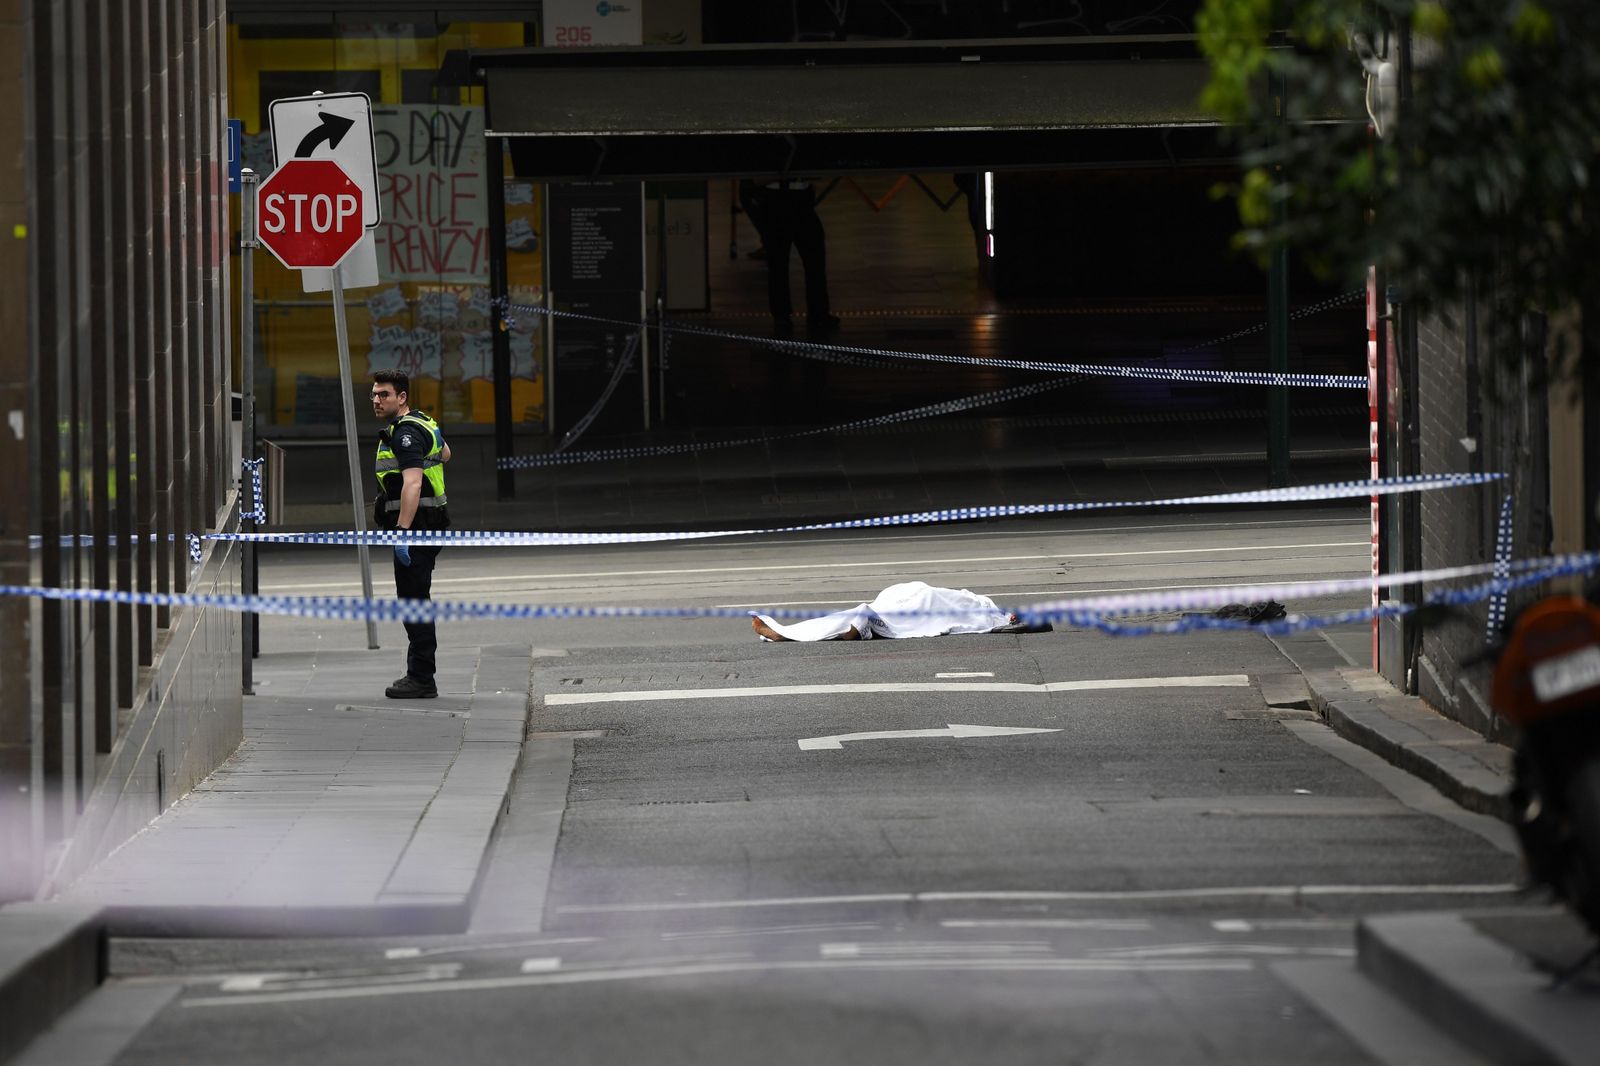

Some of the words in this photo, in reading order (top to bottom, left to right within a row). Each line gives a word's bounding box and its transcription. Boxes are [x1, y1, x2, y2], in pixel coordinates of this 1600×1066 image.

[555, 26, 592, 42] 206
[372, 110, 400, 168] 5
[409, 110, 472, 168] DAY
[264, 193, 358, 233] STOP
[378, 172, 479, 227] PRICE
